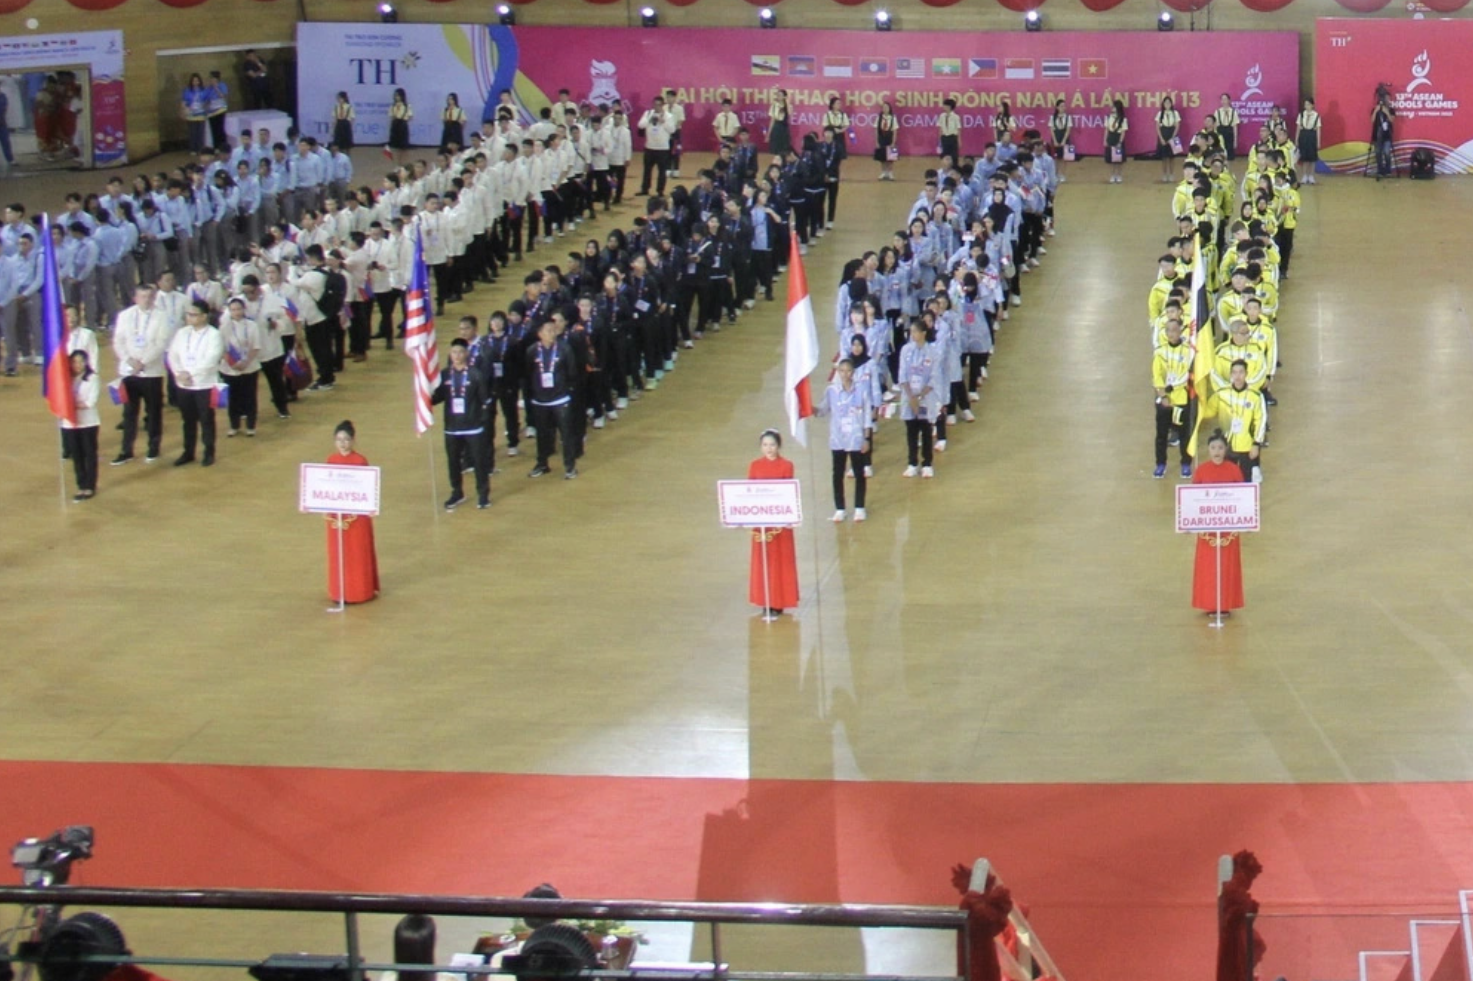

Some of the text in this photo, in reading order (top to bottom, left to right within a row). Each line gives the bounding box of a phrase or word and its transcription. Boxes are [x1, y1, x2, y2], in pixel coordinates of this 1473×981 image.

[349, 58, 399, 85] TH
[786, 88, 839, 106] THAO
[845, 90, 891, 110] HỌC
[895, 91, 943, 108] SINH
[1016, 92, 1065, 109] NAM
[1181, 92, 1201, 109] 13
[1412, 93, 1443, 101] ASEAN
[1390, 100, 1459, 109] HOOLS GAMES
[963, 115, 985, 128] DA
[312, 489, 369, 503] MALAYSIA
[729, 505, 793, 516] INDONESIA
[1198, 504, 1237, 515] BRUNEI
[1182, 516, 1254, 527] DARUSSALAM
